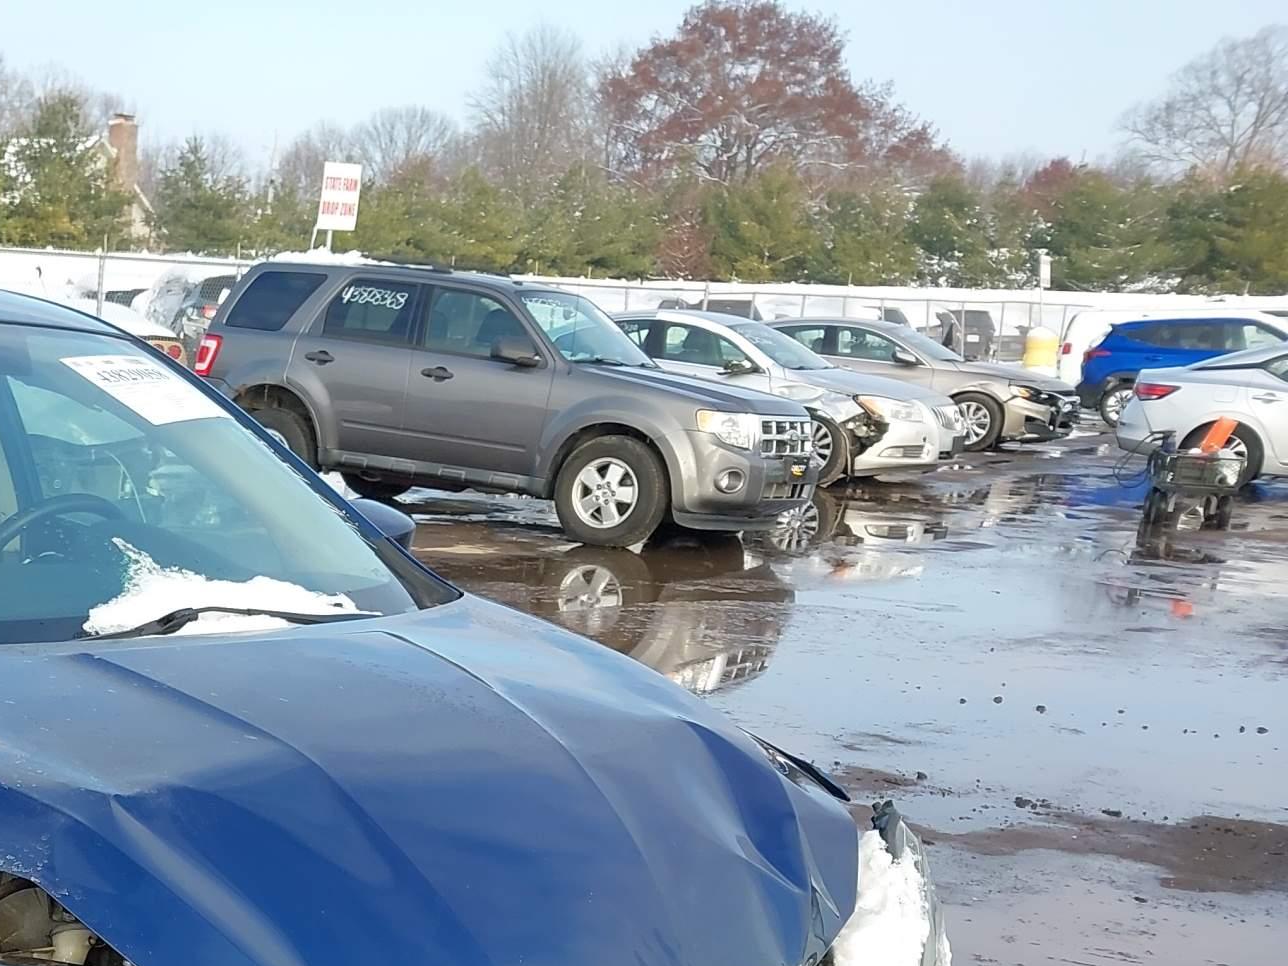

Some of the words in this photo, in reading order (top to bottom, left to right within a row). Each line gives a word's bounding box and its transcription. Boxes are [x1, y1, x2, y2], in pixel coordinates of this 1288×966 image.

[324, 176, 342, 191] STATE
[343, 176, 359, 192] FARM
[321, 200, 339, 215] DROP
[340, 201, 356, 217] ZONE
